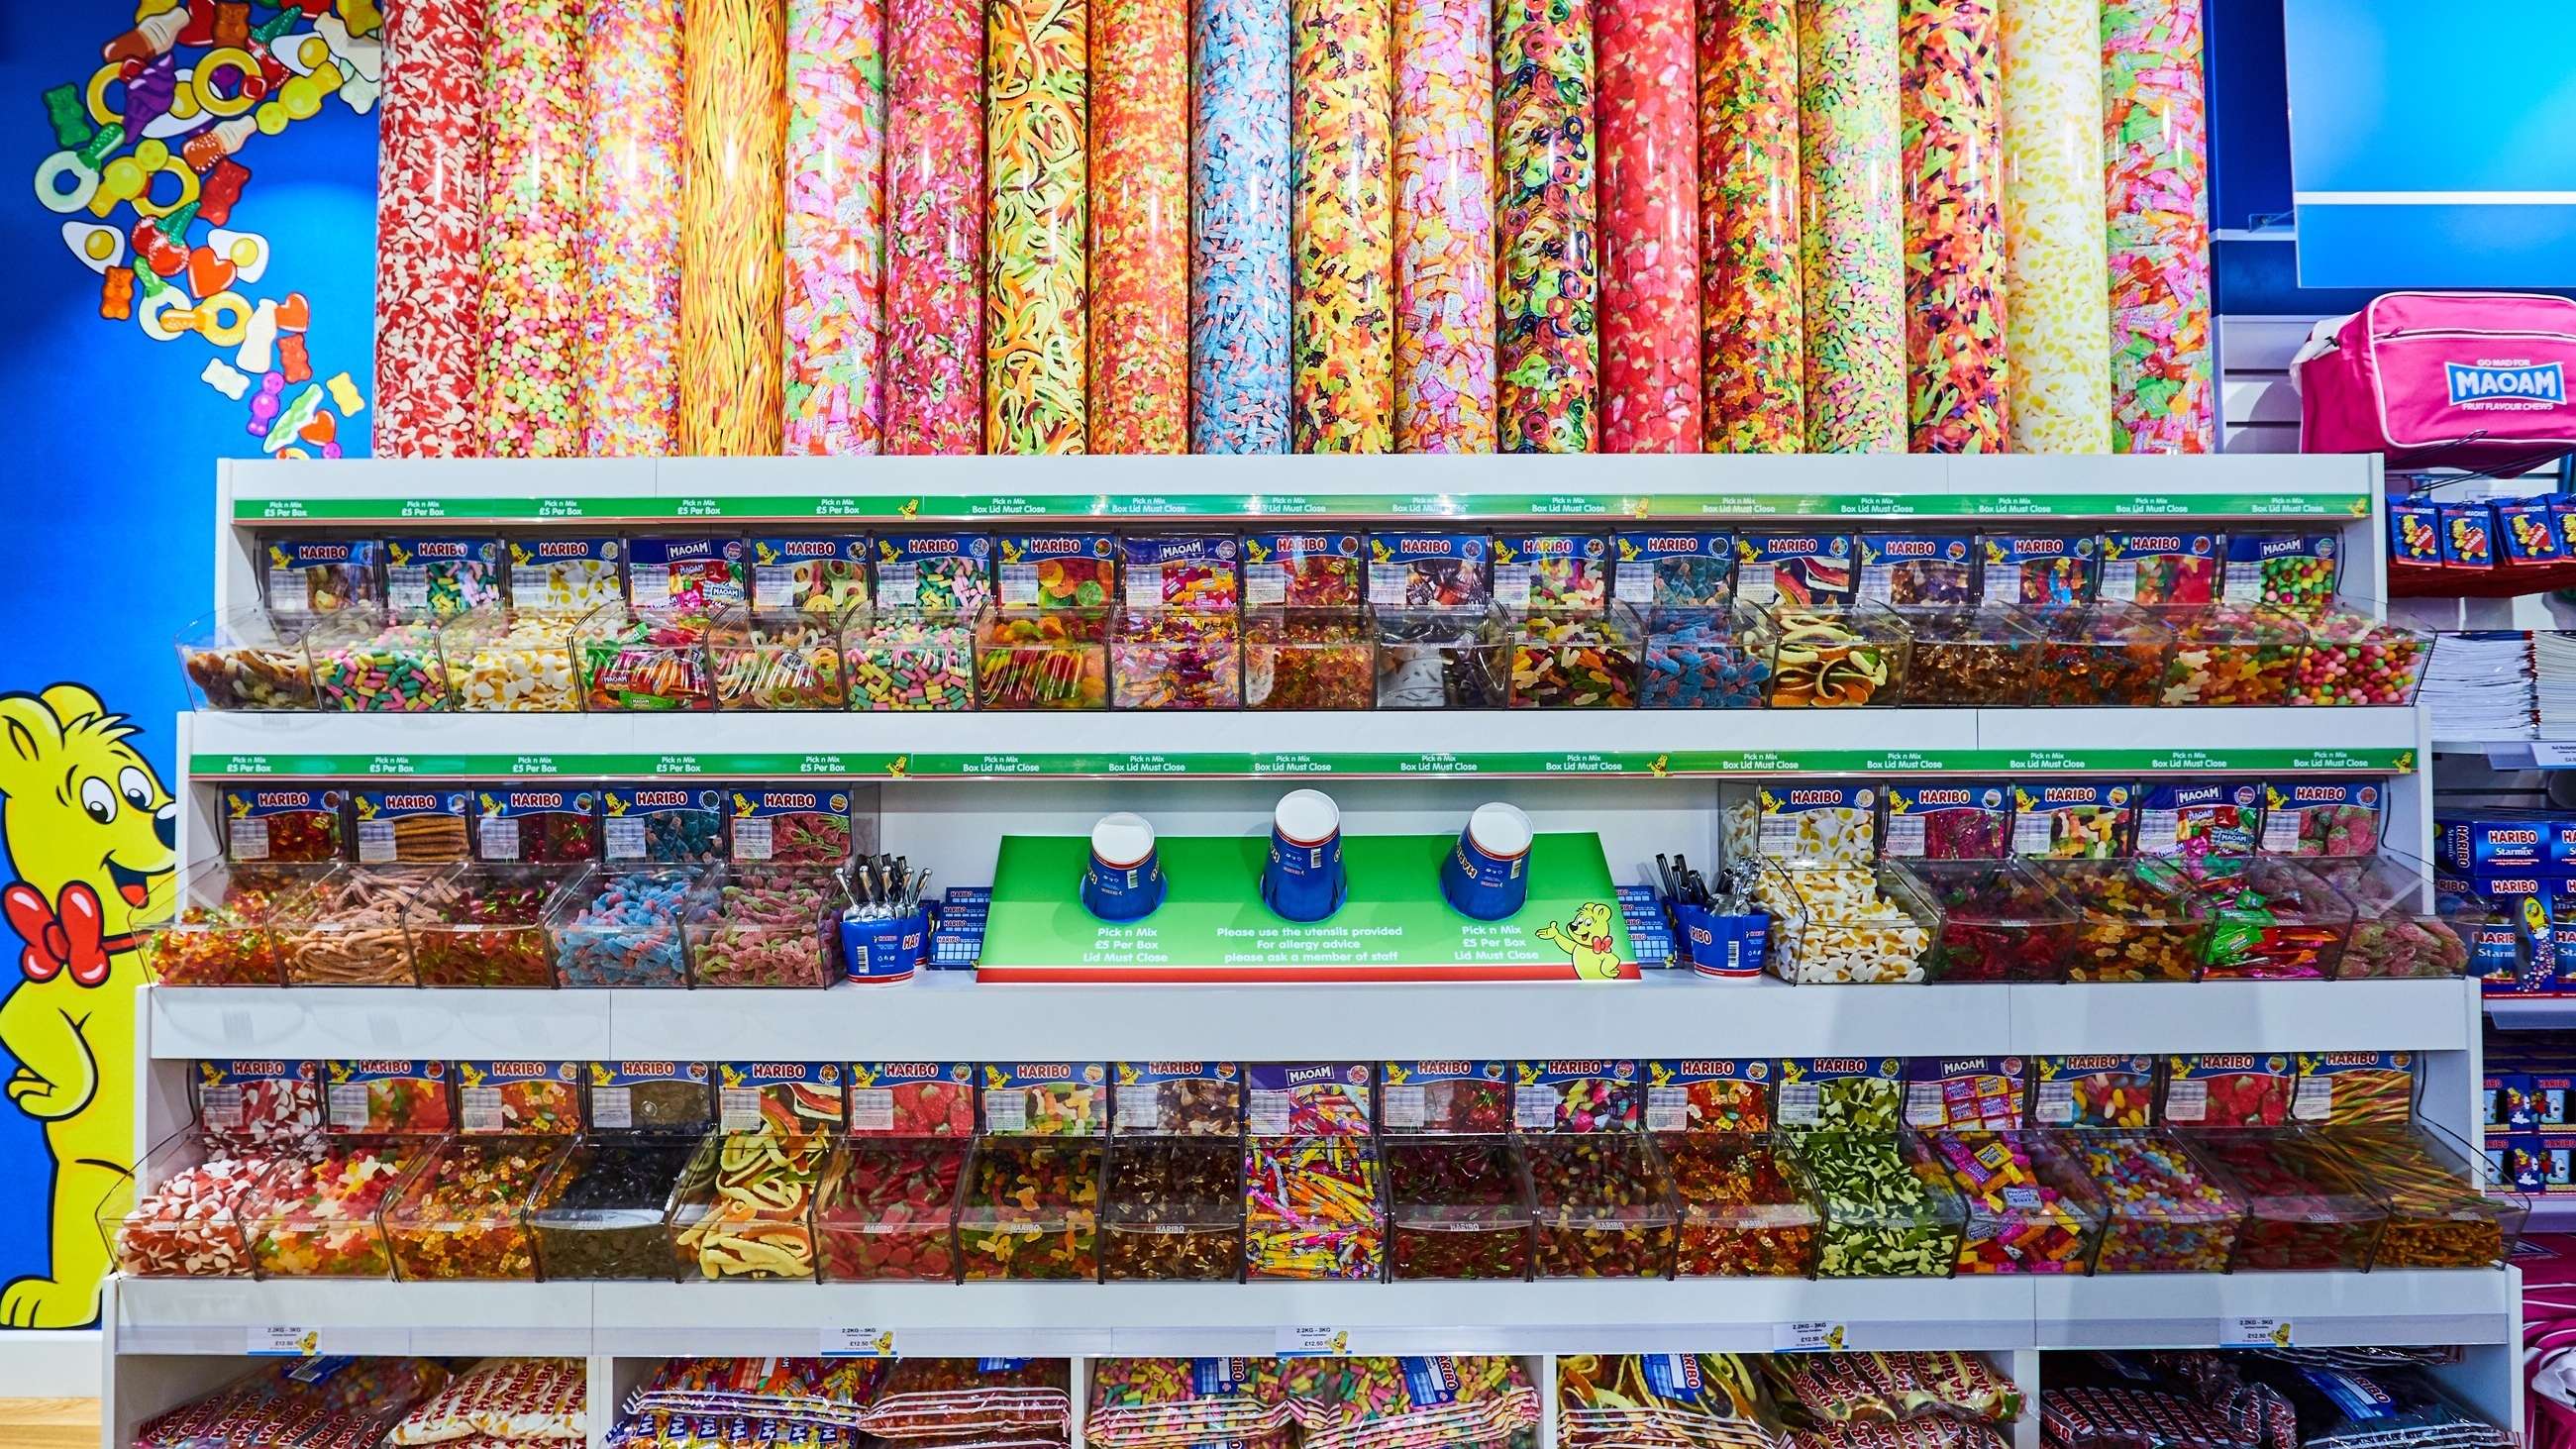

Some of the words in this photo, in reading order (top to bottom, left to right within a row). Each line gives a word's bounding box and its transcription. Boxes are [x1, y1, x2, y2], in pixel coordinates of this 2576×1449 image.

[2456, 371, 2555, 397] MAOAM
[418, 543, 467, 557] HARIBO
[539, 543, 588, 557] HARIBO
[670, 542, 709, 558] MAOAM
[785, 542, 835, 555] HARIBO
[909, 539, 958, 553] HARIBO
[1031, 539, 1081, 553] HARIBO
[1163, 542, 1200, 557] MAOAM
[1277, 539, 1327, 552] HARIBO
[1400, 540, 1451, 554] HARIBO
[1523, 540, 1573, 554] HARIBO
[1648, 539, 1698, 552] HARIBO
[1768, 539, 1817, 553] HARIBO
[1886, 541, 1935, 555] HARIBO
[2014, 540, 2063, 554] HARIBO
[2131, 538, 2180, 551] HARIBO
[2263, 540, 2301, 555] MAOAM
[299, 547, 347, 560] HARIBO
[679, 563, 704, 573] MAOAM
[258, 793, 309, 807] HARIBO
[511, 793, 562, 807] HARIBO
[636, 791, 687, 805] HARIBO
[1792, 790, 1842, 803] HARIBO
[1919, 790, 1971, 803] HARIBO
[2045, 788, 2097, 801] HARIBO
[2179, 788, 2218, 803] MAOAM
[2295, 787, 2346, 800] HARIBO
[385, 796, 437, 809] HARIBO
[765, 794, 816, 808] HARIBO
[2187, 809, 2214, 820] MAOAM
[2488, 830, 2538, 844] HARIBO
[2456, 825, 2470, 868] HARIBO
[2492, 880, 2537, 892] HARIBO
[1098, 928, 1121, 937] Pick
[1136, 928, 1157, 937] Mix
[1217, 928, 1255, 937] Please
[1283, 928, 1300, 937] the
[1304, 927, 1348, 936] utensils
[1352, 927, 1402, 937] provided
[1462, 926, 1486, 935] Pick
[1257, 940, 1274, 949] For
[1279, 940, 1319, 951] allergy
[1323, 940, 1360, 949] advice
[1463, 939, 1477, 948] £5
[1083, 953, 1100, 962] Lid
[1104, 953, 1133, 962] Must
[1137, 953, 1168, 962] Close
[1224, 953, 1264, 964] please
[1268, 953, 1288, 962] ask
[1355, 952, 1367, 961] of
[1371, 952, 1397, 961] staff
[1454, 951, 1472, 960] Lid
[1476, 951, 1503, 960] Must
[1507, 951, 1539, 960] Close
[1814, 1059, 1867, 1073] HARIBO
[2067, 1056, 2119, 1070] HARIBO
[2202, 1055, 2254, 1069] HARIBO
[2326, 1053, 2378, 1066] HARIBO
[233, 1062, 285, 1076] HARIBO
[360, 1061, 411, 1075] HARIBO
[493, 1062, 546, 1076] HARIBO
[622, 1062, 674, 1076] HARIBO
[752, 1064, 805, 1078] HARIBO
[885, 1064, 938, 1078] HARIBO
[1017, 1065, 1071, 1079] HARIBO
[1149, 1062, 1202, 1075] HARIBO
[1418, 1061, 1472, 1075] HARIBO
[1549, 1061, 1601, 1075] HARIBO
[1682, 1061, 1735, 1076] HARIBO
[1945, 1060, 1986, 1074] MAOAM
[1289, 1067, 1331, 1083] MAOAM
[1010, 1224, 1040, 1233] HARIBO
[1155, 1224, 1185, 1234] HARIBO
[456, 1370, 491, 1416] HARIBO
[499, 1363, 535, 1411] HARIBO
[519, 1364, 557, 1414] HARIBO
[541, 1368, 578, 1414] HARIBO
[209, 1394, 262, 1439] HARIBO
[232, 1397, 285, 1442] HARIBO
[278, 1408, 329, 1445] HARIBO
